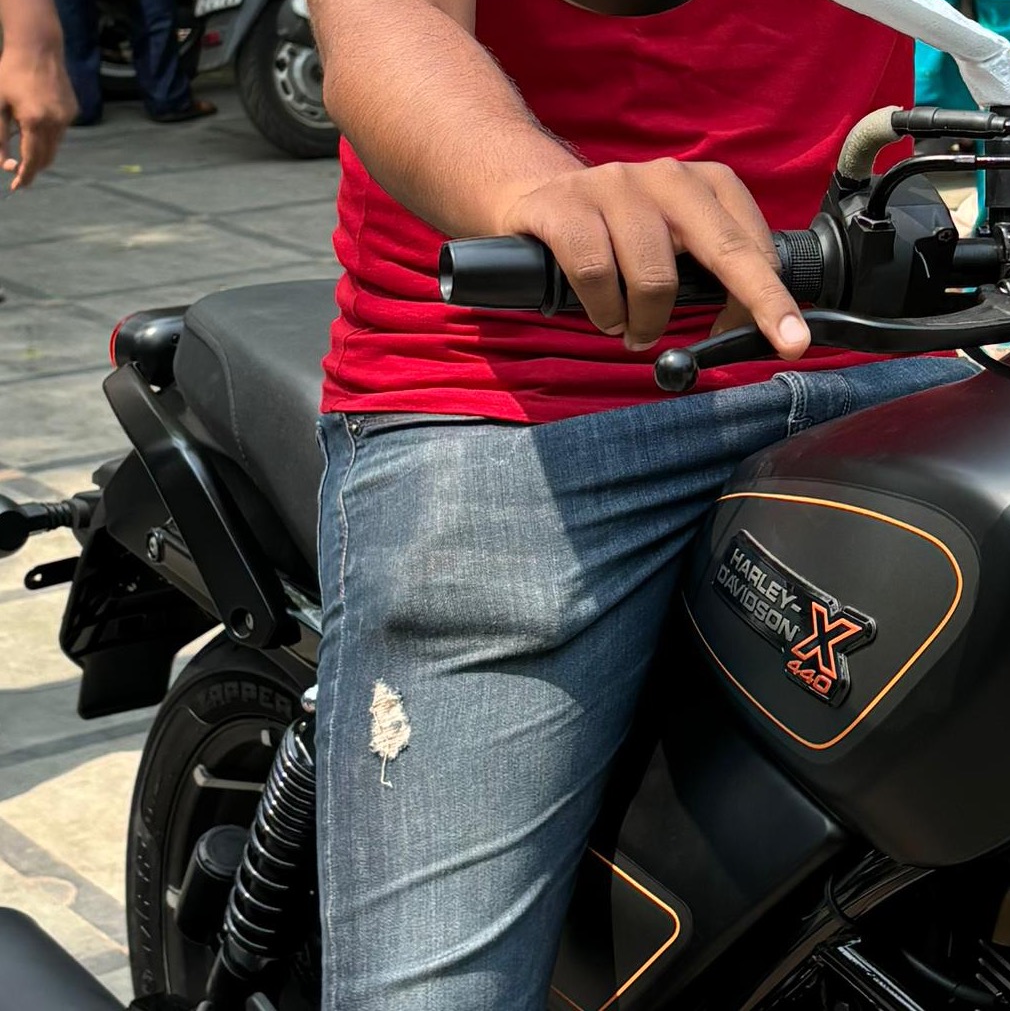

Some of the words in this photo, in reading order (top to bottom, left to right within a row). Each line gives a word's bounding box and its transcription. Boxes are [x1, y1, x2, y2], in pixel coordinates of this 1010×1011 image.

[717, 563, 800, 642] DAVIDSON
[730, 548, 802, 613] HARLEY-
[790, 601, 862, 680] X
[786, 660, 833, 694] 440
